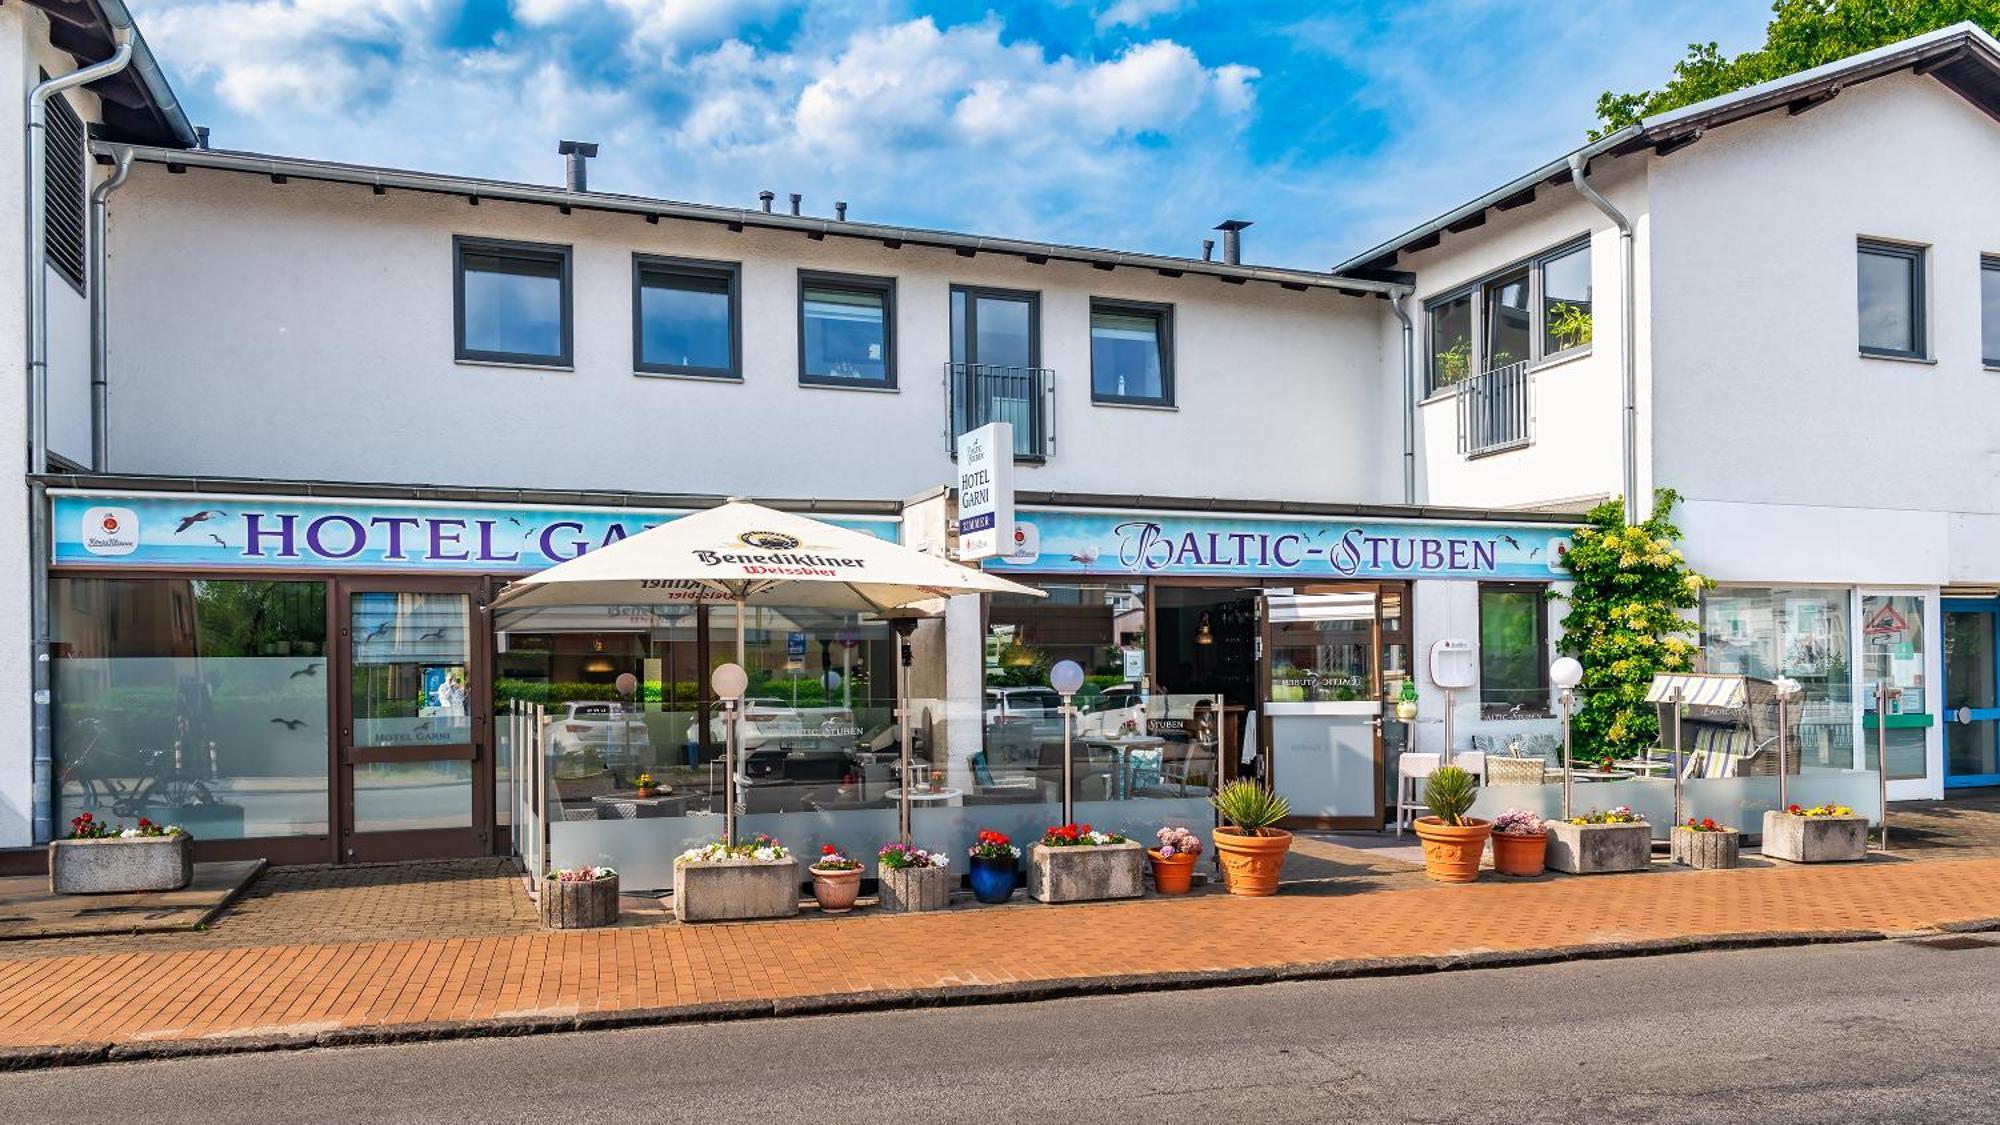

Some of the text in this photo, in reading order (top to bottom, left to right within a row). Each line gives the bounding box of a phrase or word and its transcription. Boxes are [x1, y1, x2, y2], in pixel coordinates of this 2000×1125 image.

[961, 469, 990, 491] HOTEL
[961, 487, 989, 509] GARNI
[241, 513, 519, 561] HOTEL
[692, 550, 866, 568] Benediktiner
[743, 565, 837, 577] Weissbier
